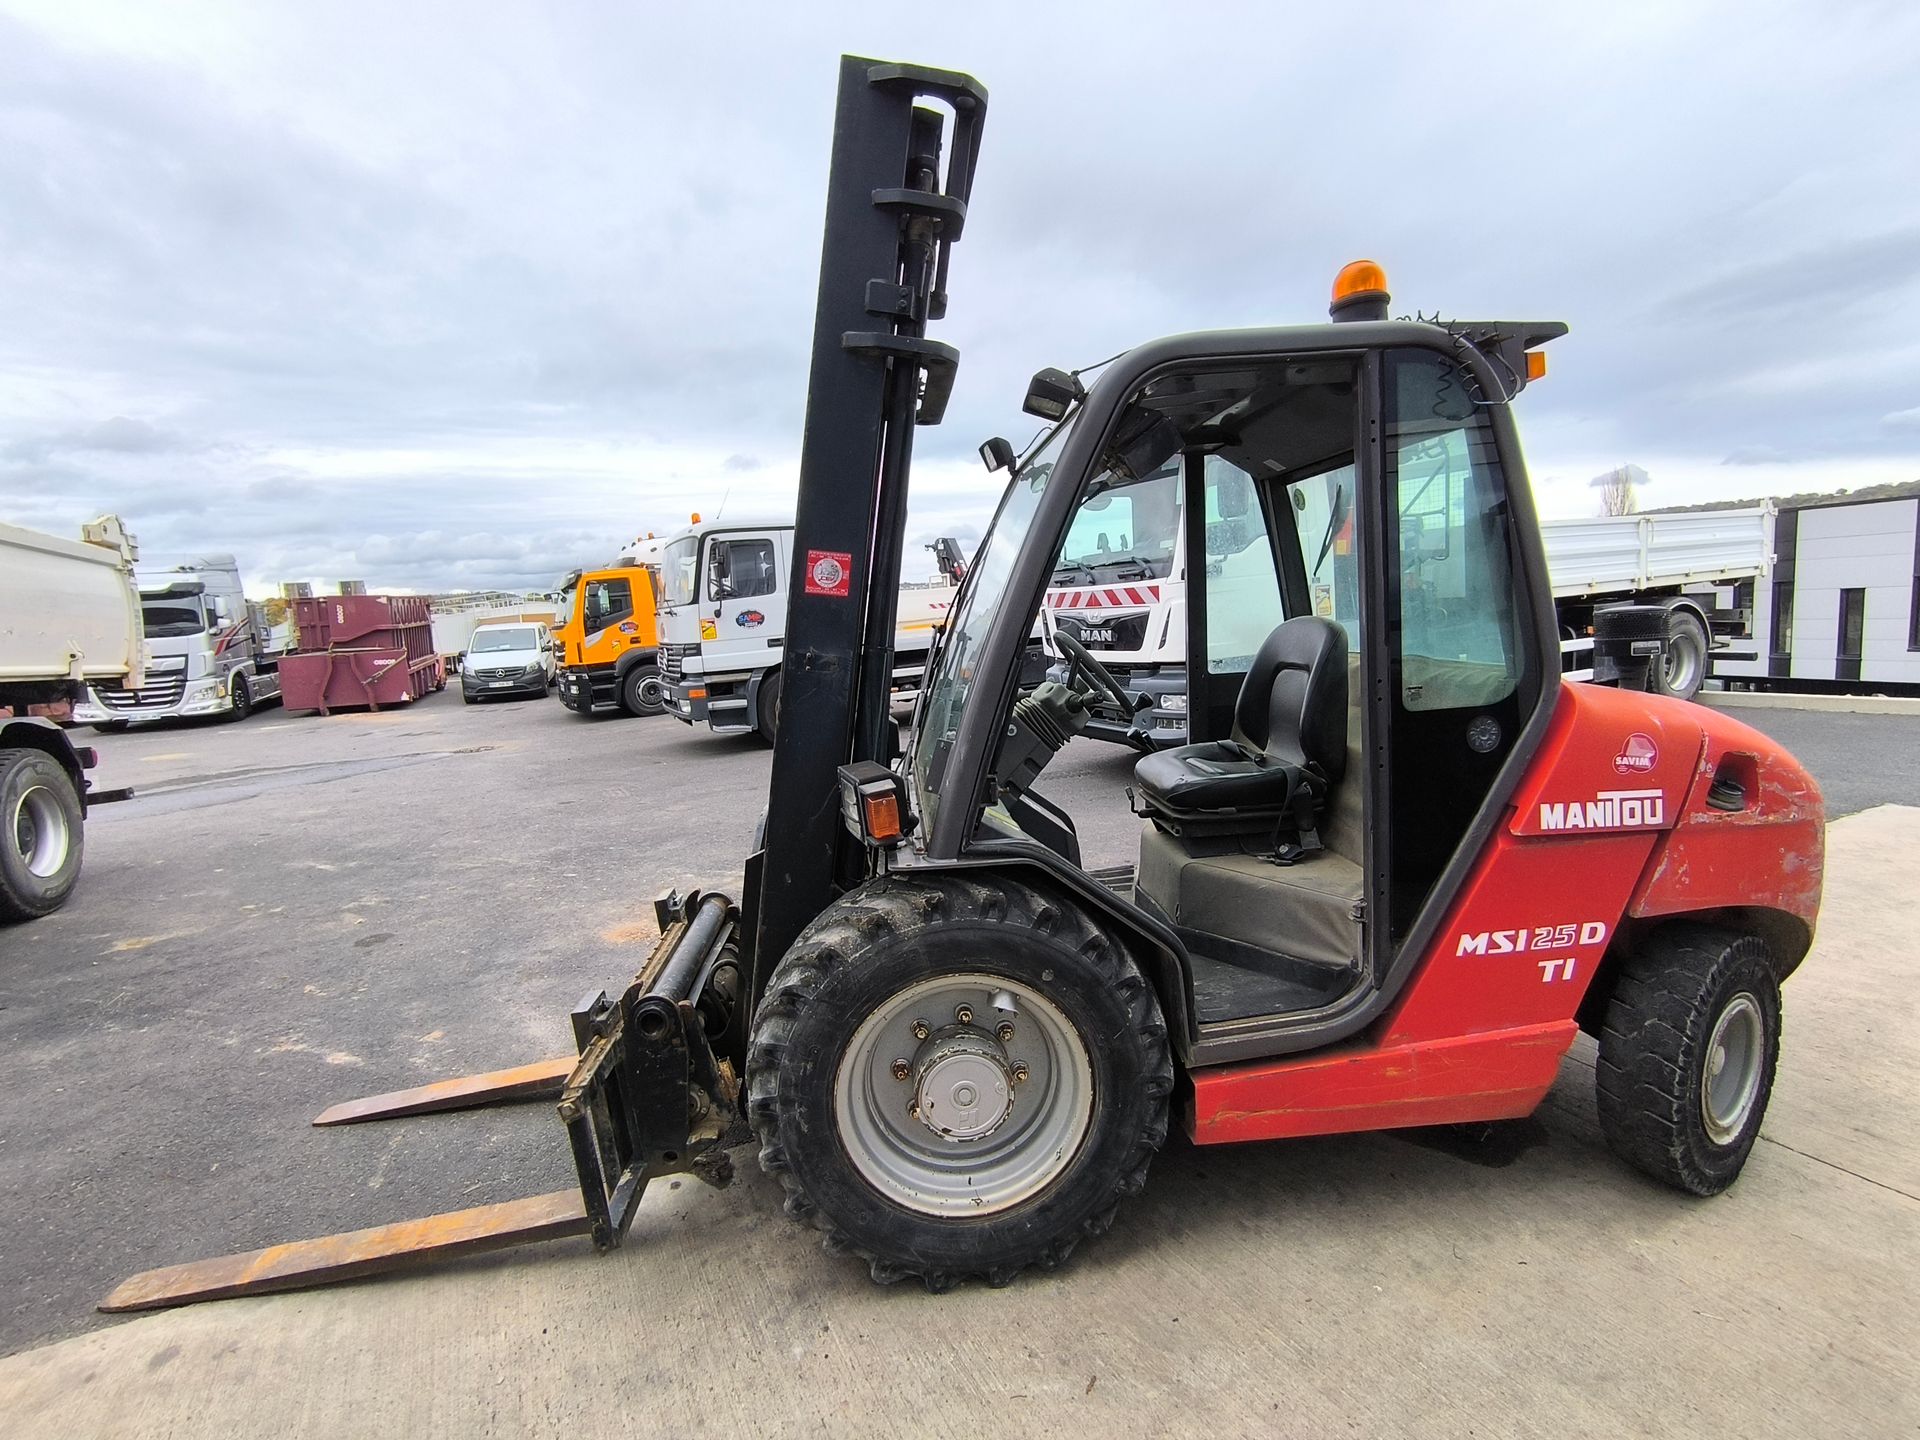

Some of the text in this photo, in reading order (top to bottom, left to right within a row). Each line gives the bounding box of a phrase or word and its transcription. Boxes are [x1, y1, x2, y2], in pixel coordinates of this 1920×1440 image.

[1080, 630, 1112, 642] MAN
[1615, 756, 1649, 766] SAVIM
[1540, 789, 1663, 830] MANITOU
[1537, 958, 1576, 983] TI
